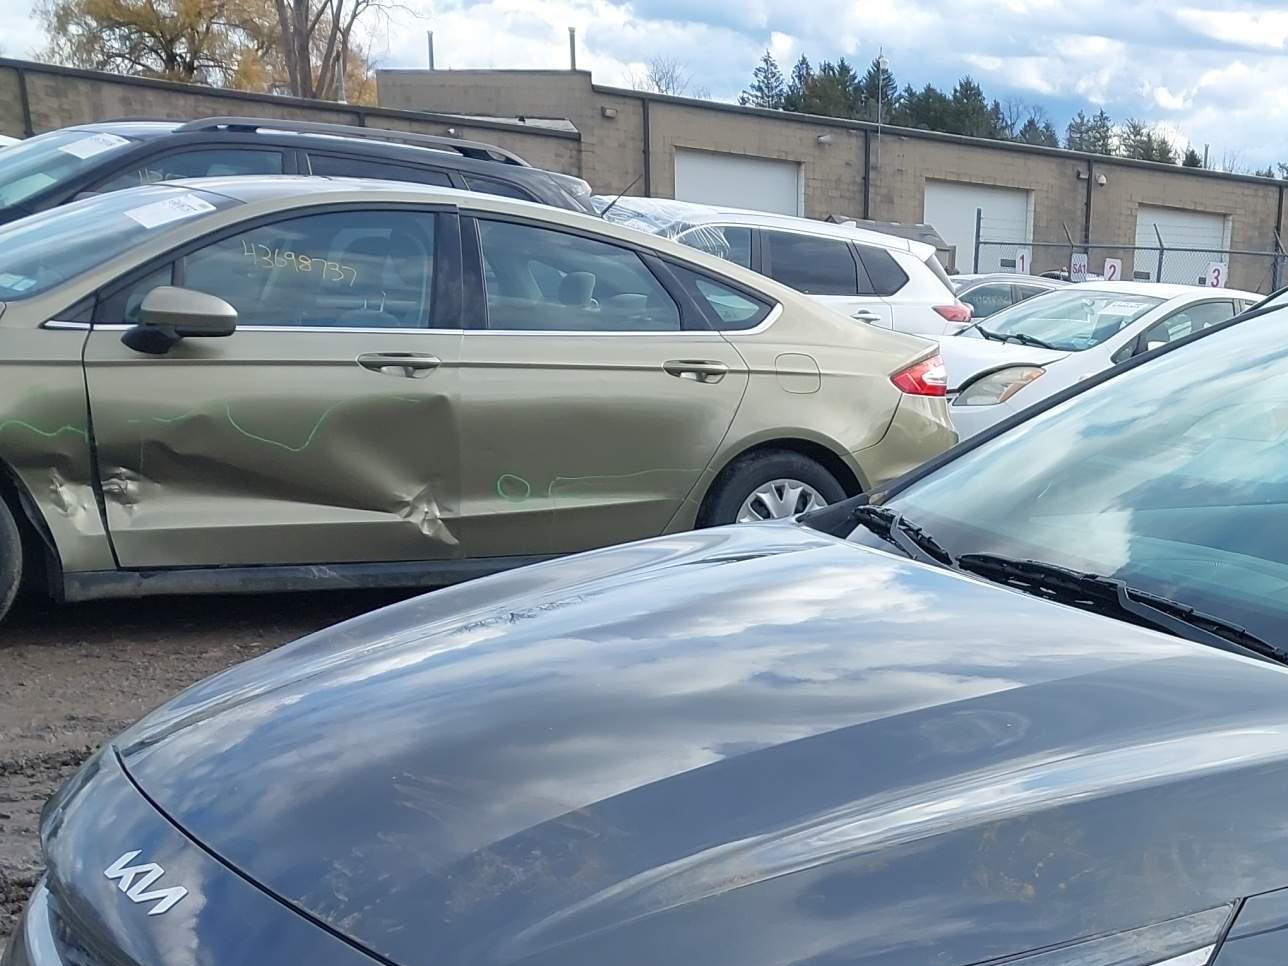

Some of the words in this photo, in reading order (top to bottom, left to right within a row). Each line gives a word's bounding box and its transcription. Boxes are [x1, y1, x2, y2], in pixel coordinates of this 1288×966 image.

[241, 239, 357, 288] 43698737
[1108, 264, 1117, 281] 2
[1211, 268, 1221, 287] 3
[103, 849, 189, 915] KIA
